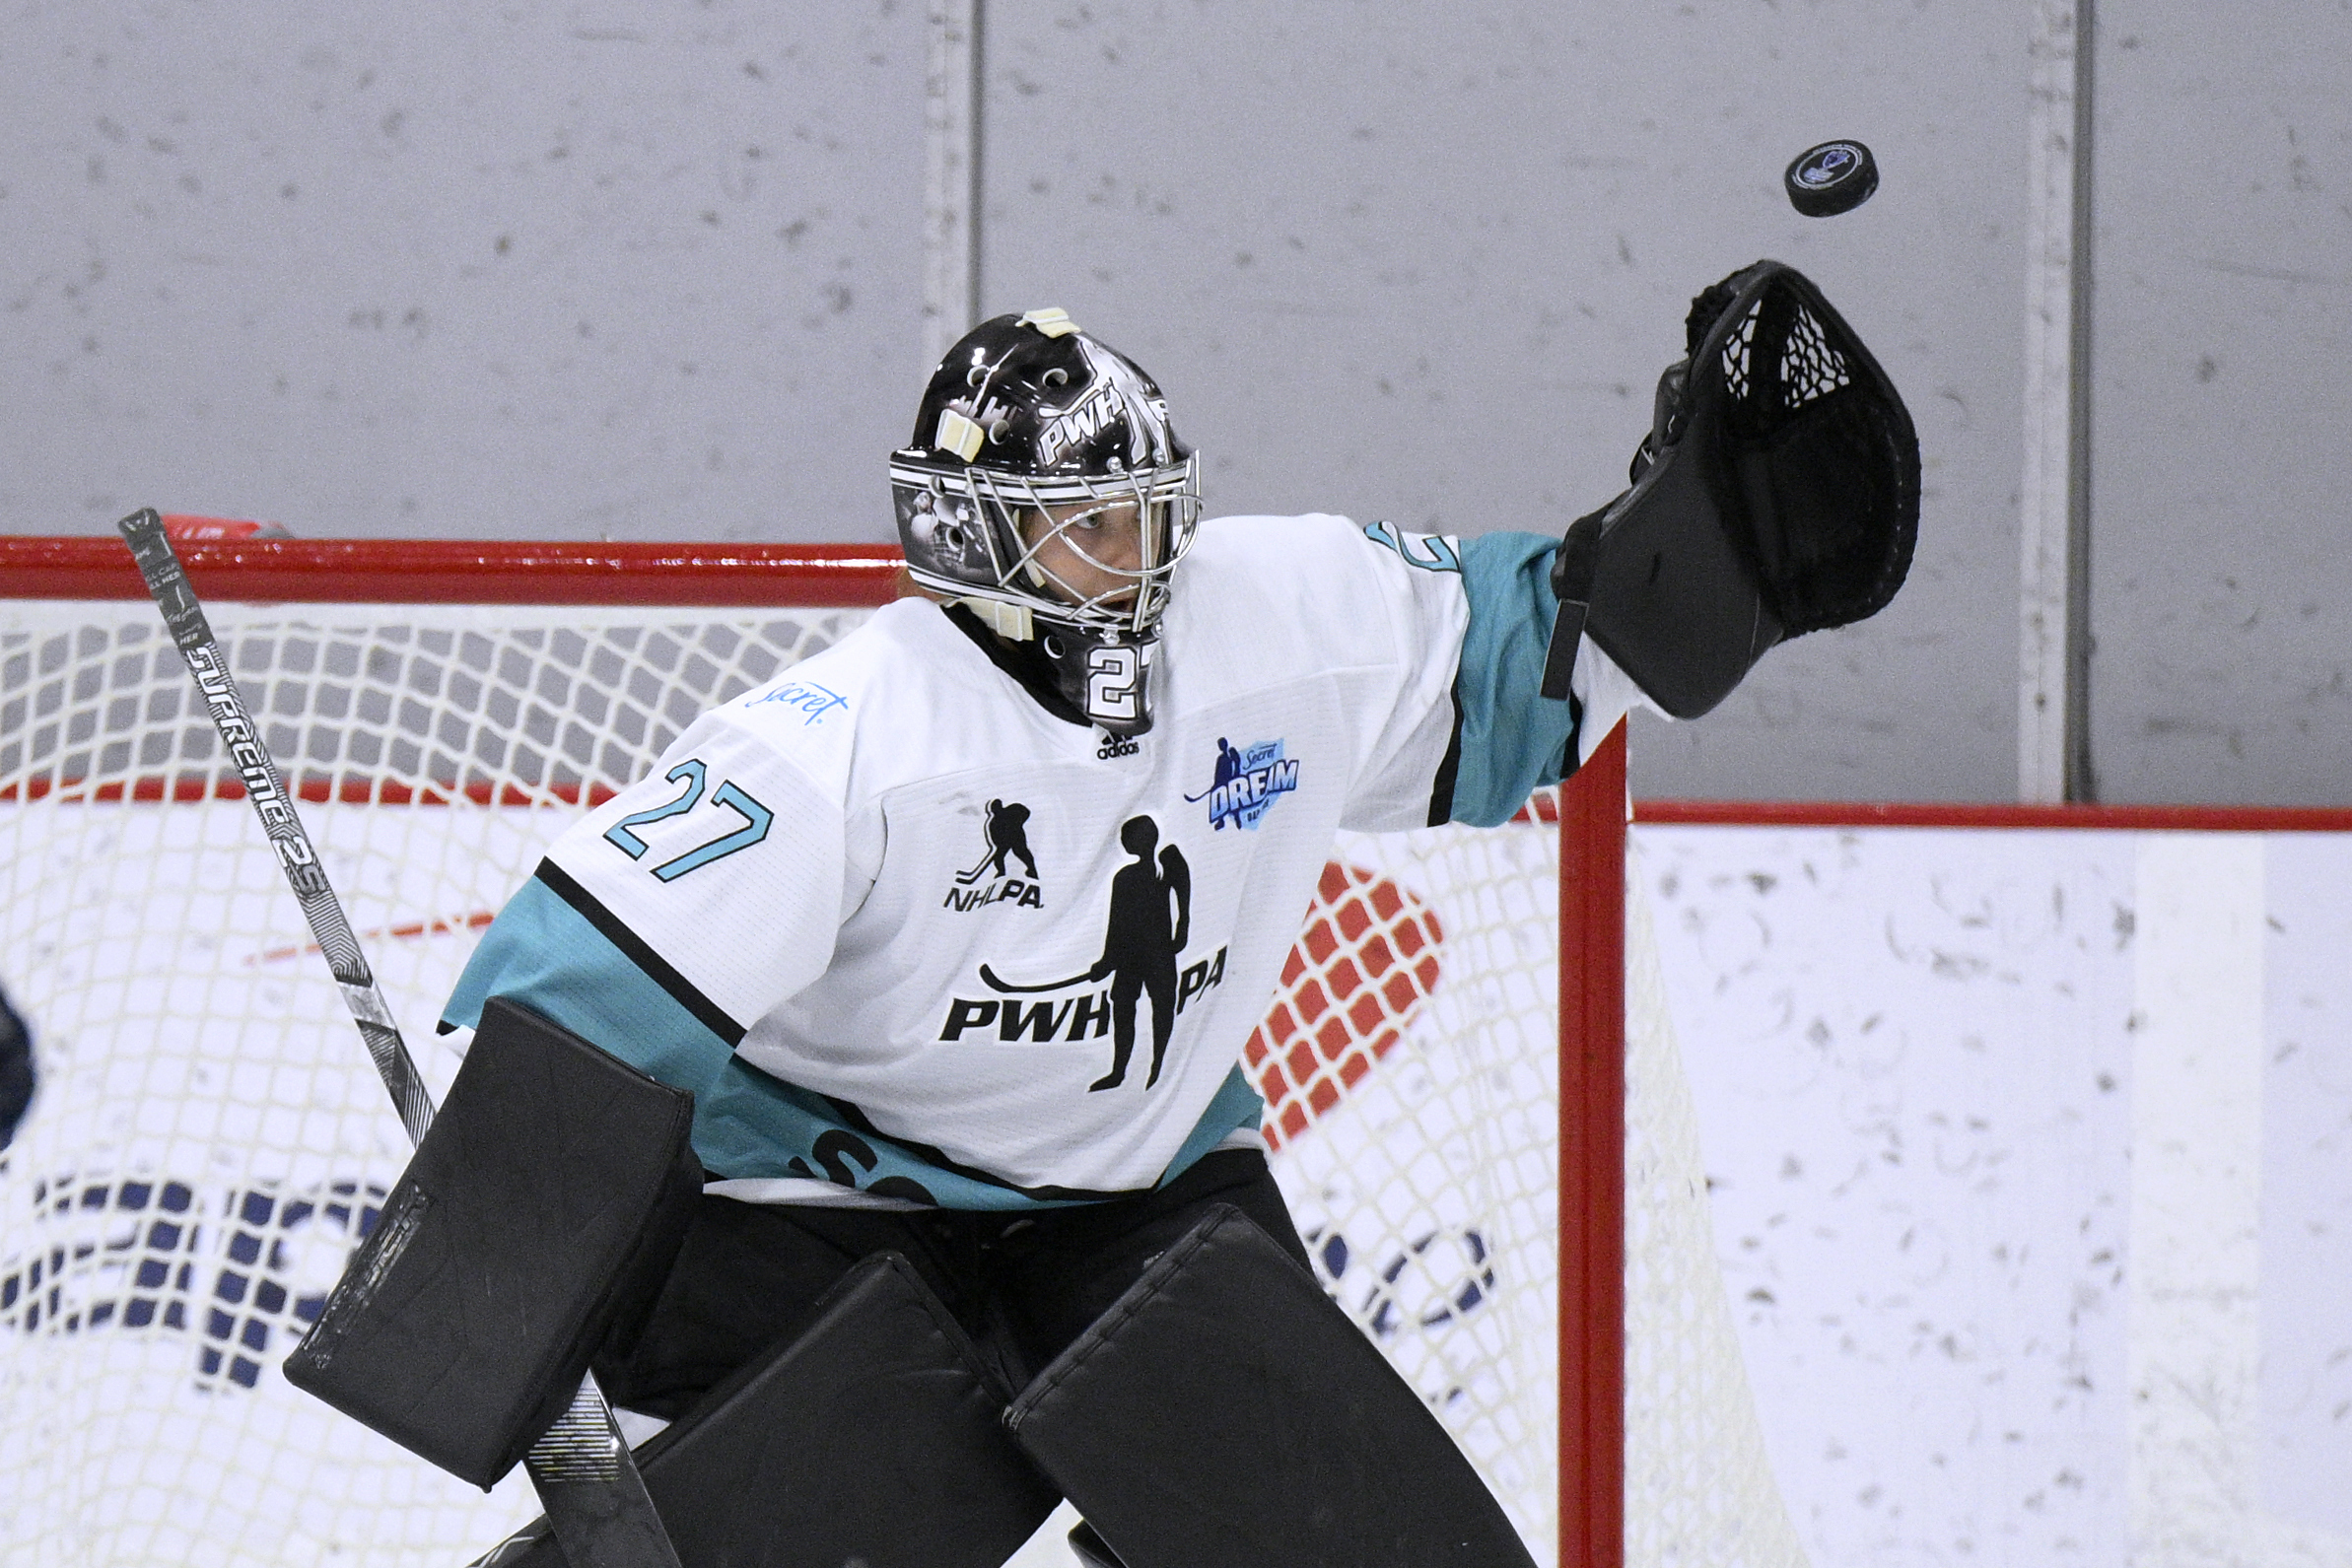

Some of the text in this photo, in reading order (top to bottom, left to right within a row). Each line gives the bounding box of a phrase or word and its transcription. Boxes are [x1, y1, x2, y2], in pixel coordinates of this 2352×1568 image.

[744, 680, 850, 727] Secret
[186, 647, 290, 825] SUPREME
[1096, 741, 1141, 760] adidas
[602, 758, 775, 883] 27
[942, 879, 1044, 913] NHLPA
